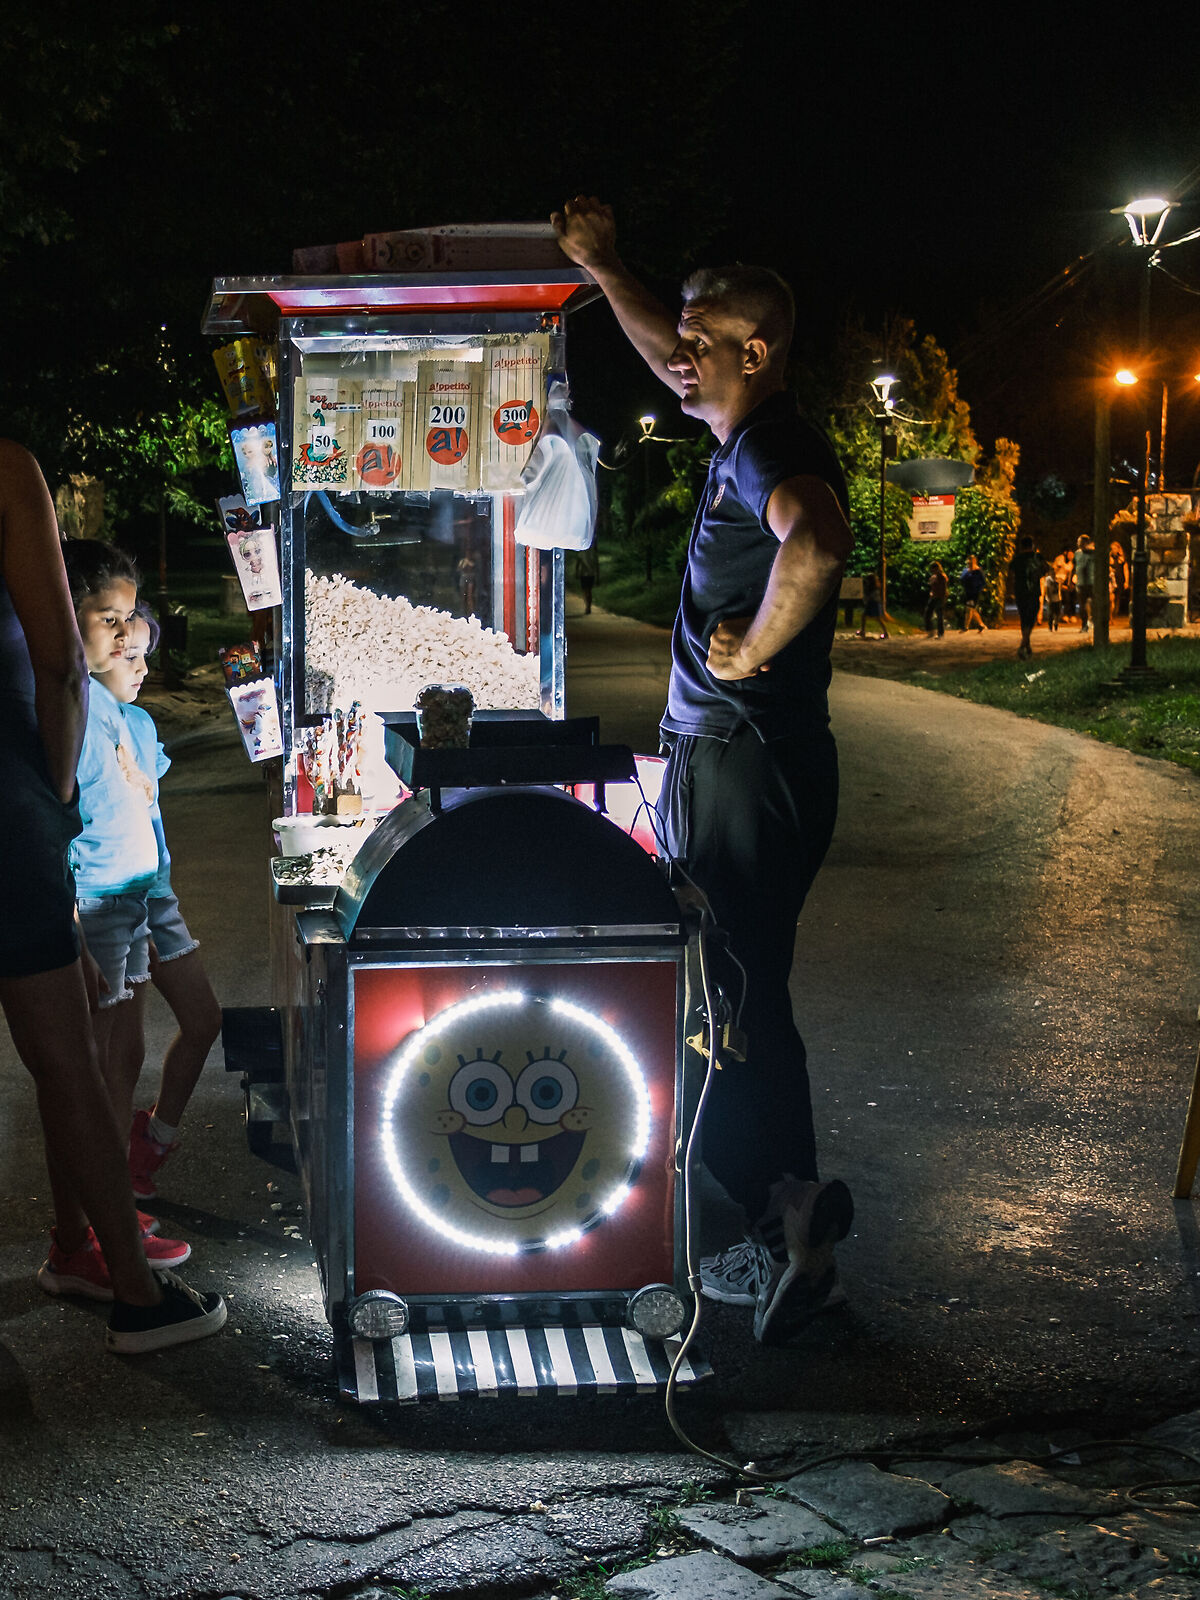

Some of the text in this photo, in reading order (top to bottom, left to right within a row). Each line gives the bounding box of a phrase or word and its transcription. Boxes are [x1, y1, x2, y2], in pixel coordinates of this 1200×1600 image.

[428, 382, 471, 393] a!ppetito
[430, 406, 466, 424] 200
[502, 409, 527, 422] 300
[371, 425, 396, 438] 100
[315, 435, 331, 448] 50
